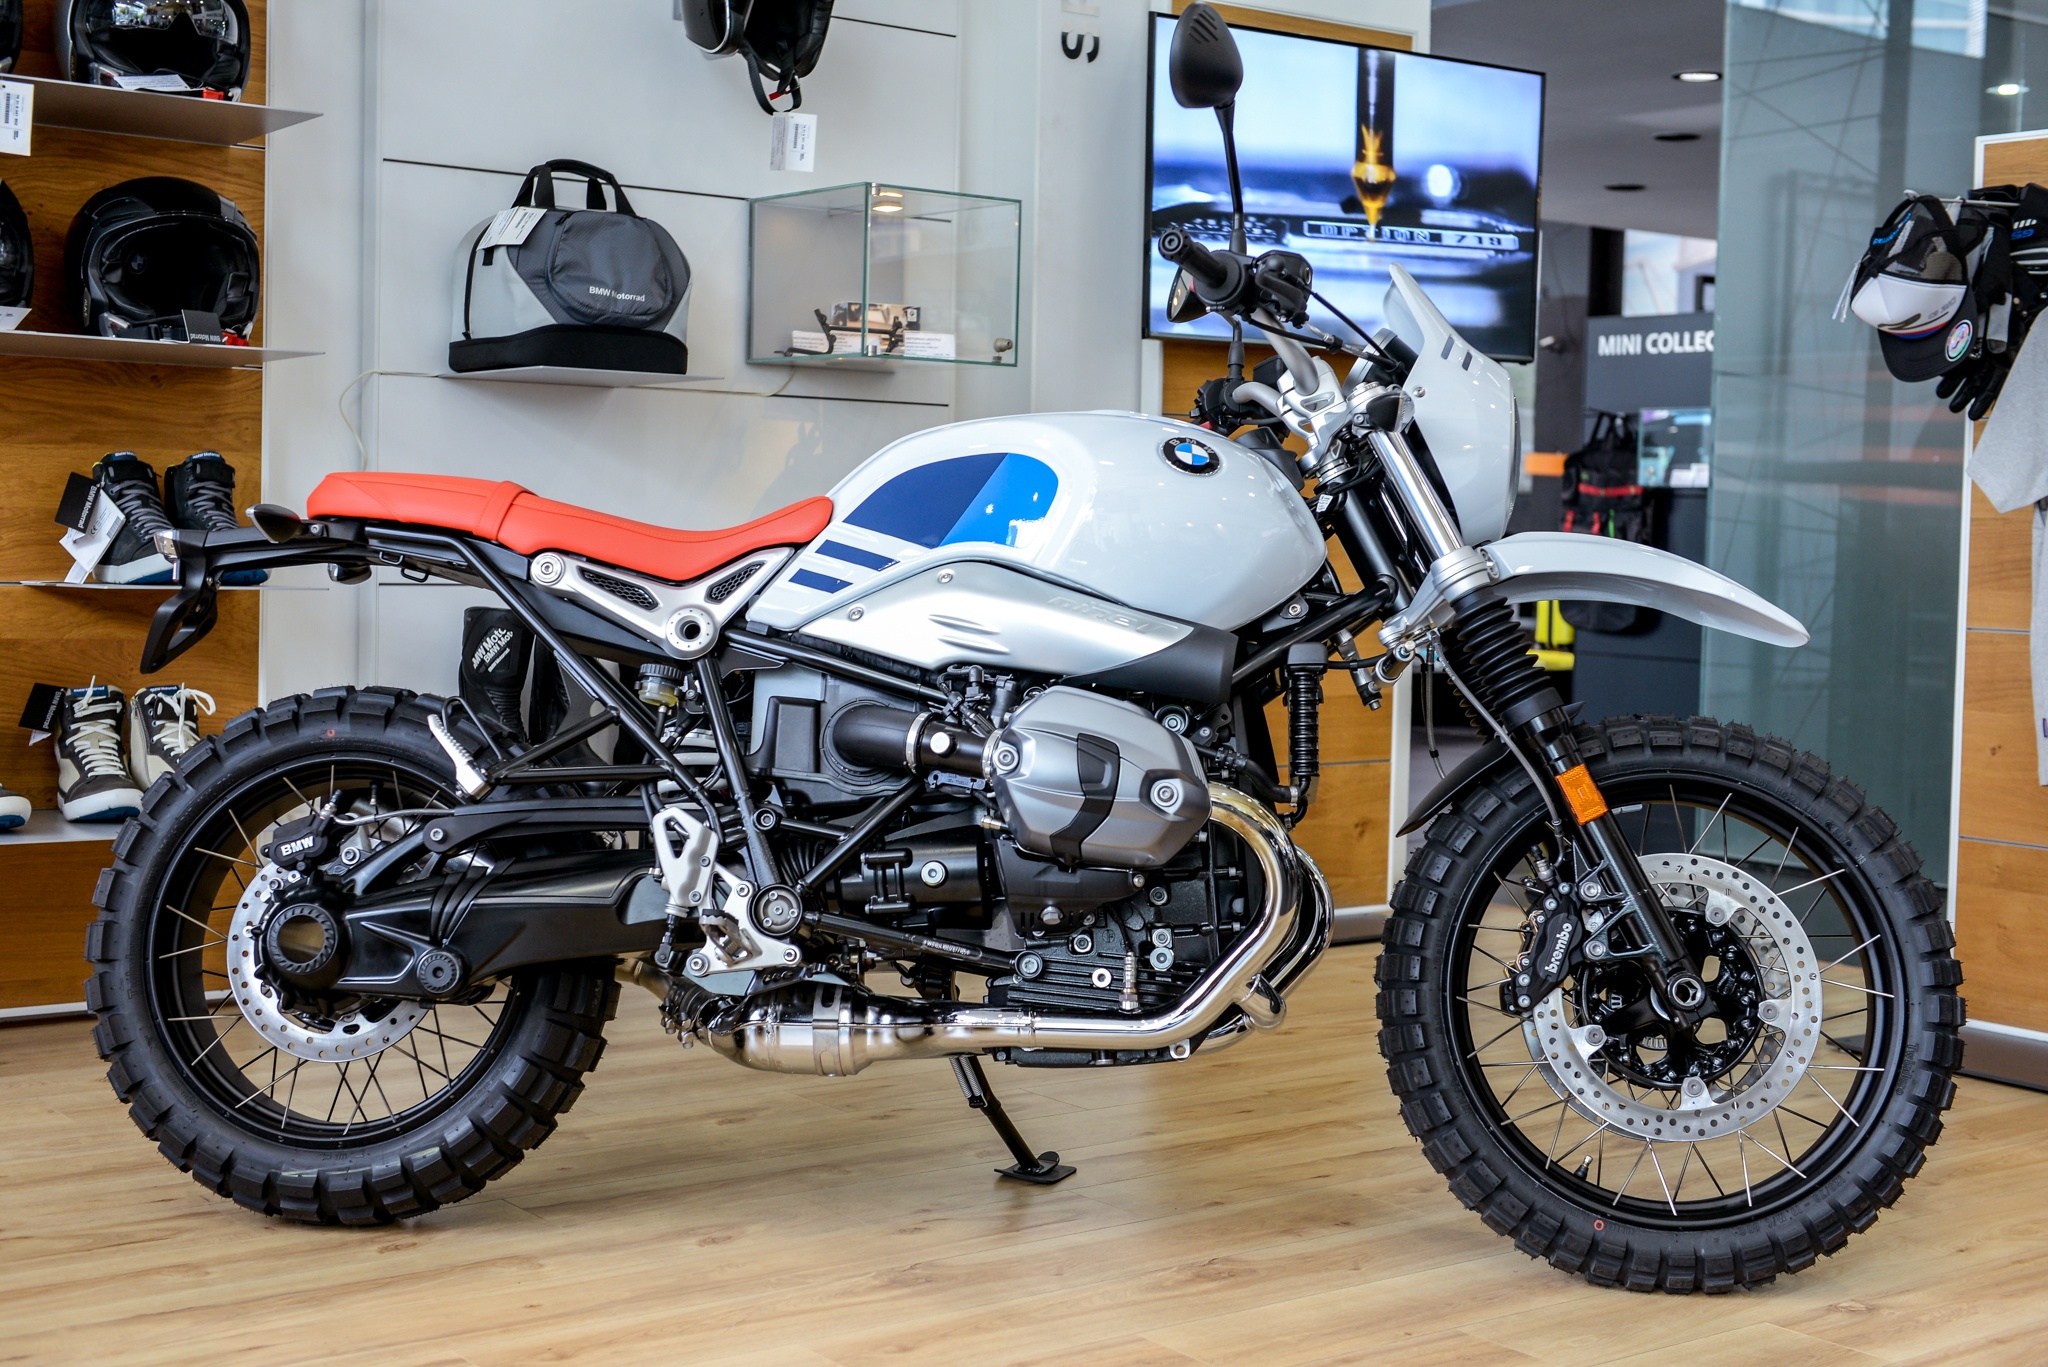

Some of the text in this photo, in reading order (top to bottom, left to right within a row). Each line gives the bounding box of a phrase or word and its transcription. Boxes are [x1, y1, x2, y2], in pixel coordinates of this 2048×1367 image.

[589, 286, 645, 302] BMW Motorrad
[1598, 334, 1642, 356] MINI
[1169, 438, 1215, 454] BMW
[78, 485, 98, 529] BMW Motorrad
[483, 643, 500, 663] BMW
[280, 835, 314, 857] BMW
[1544, 922, 1573, 974] brembo
